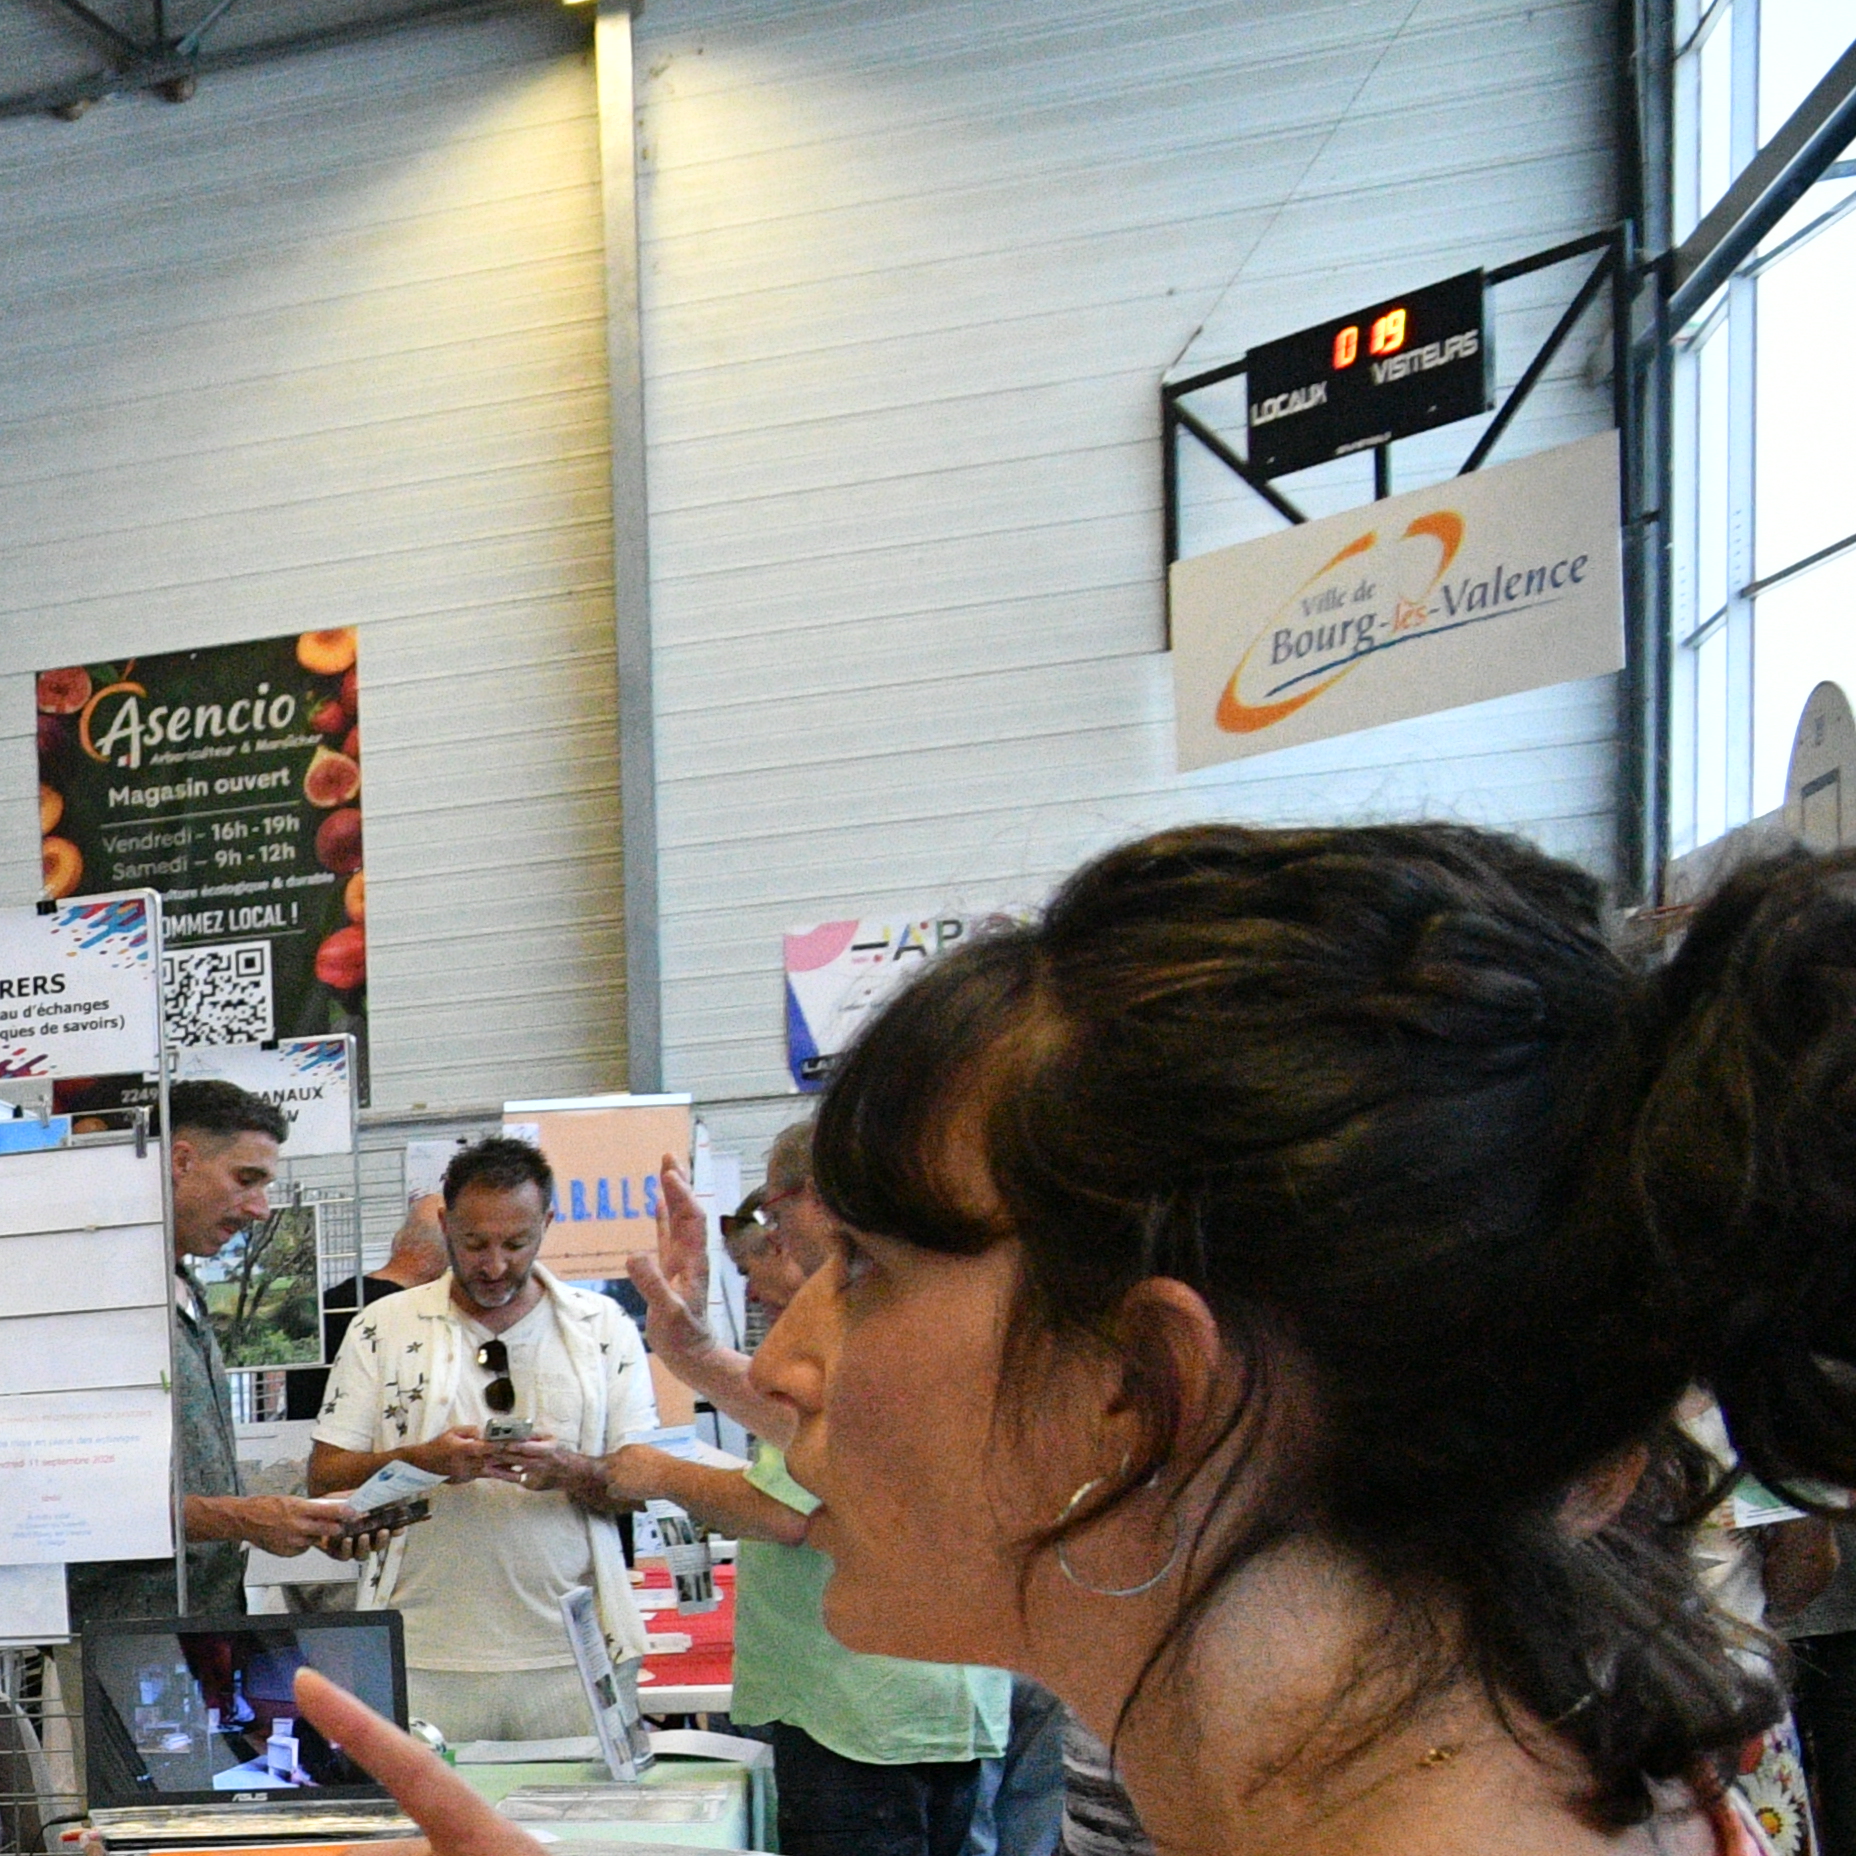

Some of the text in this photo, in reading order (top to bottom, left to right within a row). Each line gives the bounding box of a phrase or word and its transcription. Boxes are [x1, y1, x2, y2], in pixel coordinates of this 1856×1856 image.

[1370, 329, 1479, 386] VISITEURS
[1250, 381, 1327, 427] LOCAUX
[1300, 579, 1377, 617] Ville de
[95, 682, 296, 769] Asencio
[108, 767, 290, 808] Magasin ouvert
[102, 813, 300, 853] Vendredi 16h 19h
[112, 843, 295, 881] Samedi 9h 12h
[271, 876, 284, 889] &
[285, 872, 336, 888] durable
[229, 903, 286, 931] LOCAL
[0, 973, 66, 1000] RERS
[23, 1000, 109, 1019] d'échanges
[40, 1023, 58, 1035] de
[63, 1014, 125, 1033] savoirs)
